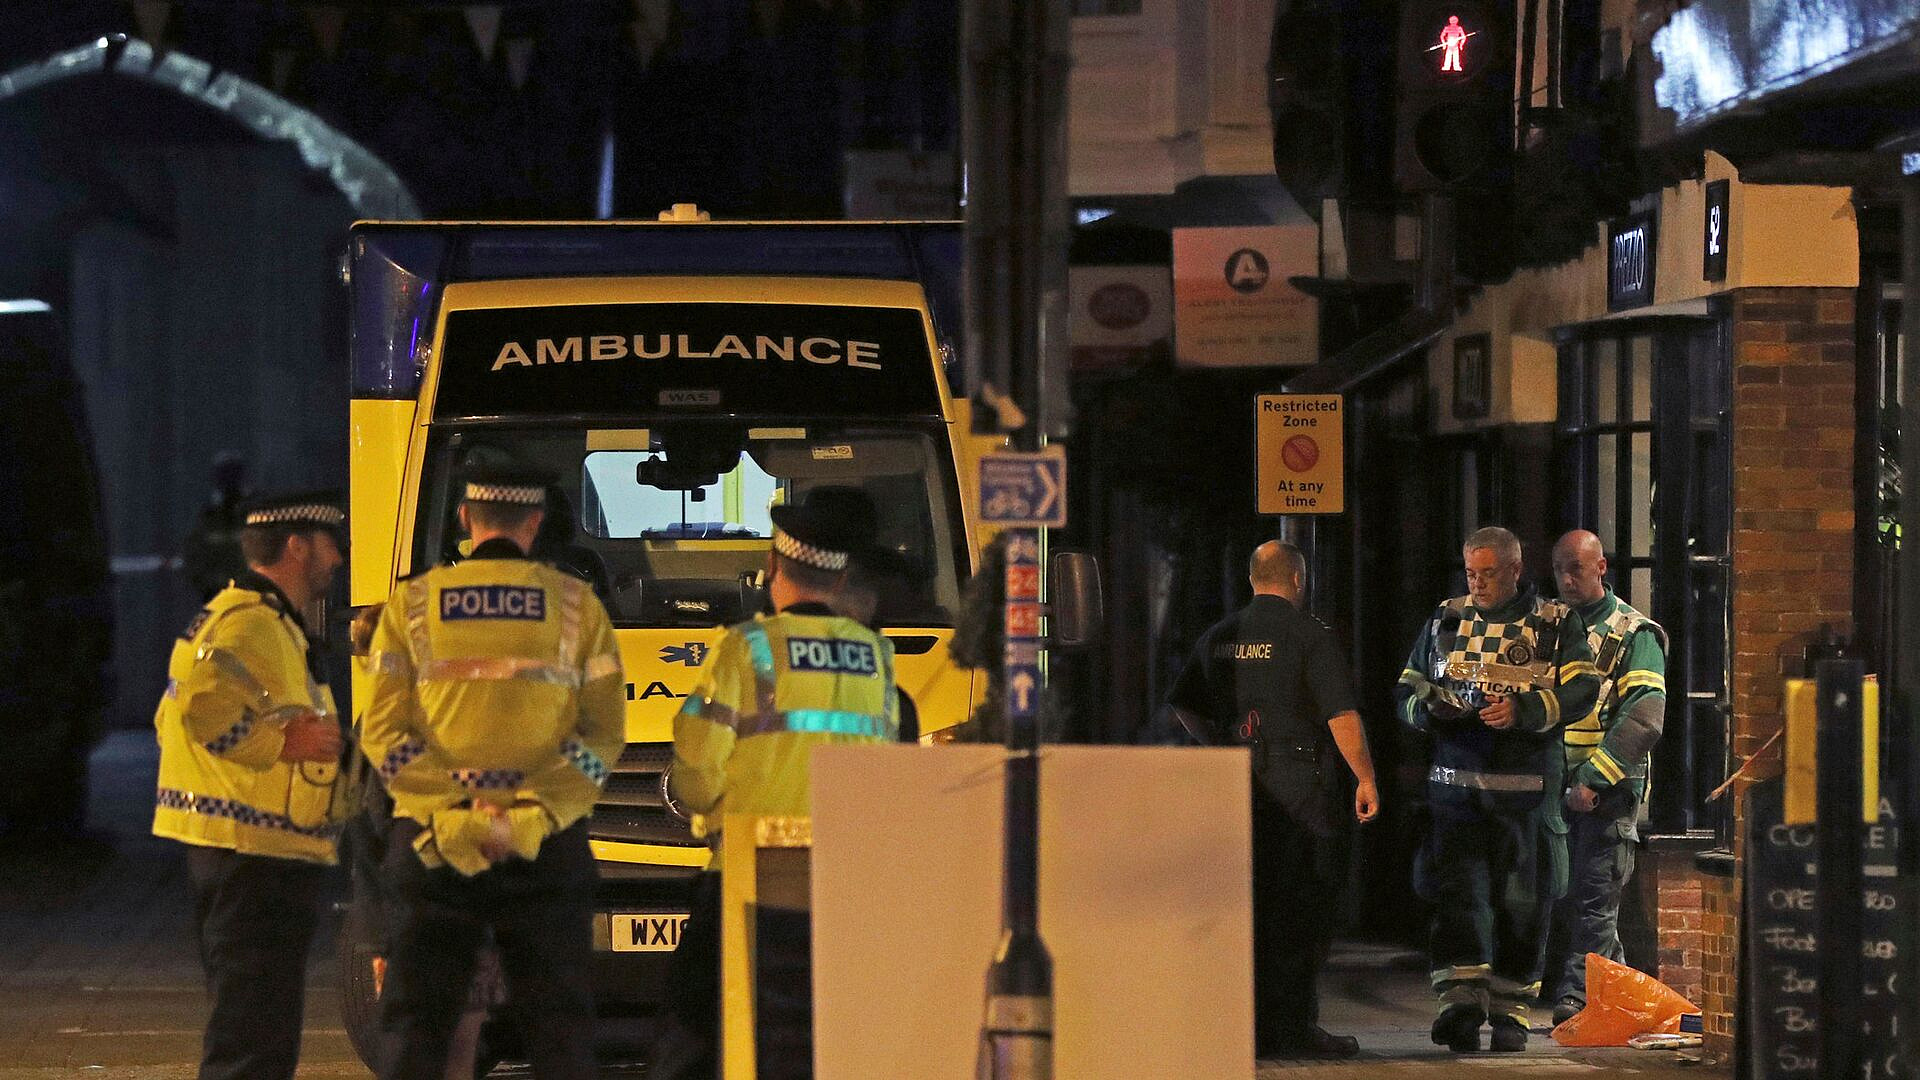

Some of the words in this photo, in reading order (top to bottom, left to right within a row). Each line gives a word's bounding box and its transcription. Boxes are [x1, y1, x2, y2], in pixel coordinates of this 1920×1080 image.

[491, 334, 882, 371] AMBULANCE
[668, 392, 709, 402] WAS
[1263, 400, 1337, 412] Restricted
[1283, 416, 1318, 427] Zone
[1278, 480, 1294, 492] At
[1299, 482, 1324, 494] any
[1285, 496, 1317, 507] time
[443, 590, 541, 616] POLICE
[791, 640, 876, 672] POLICE
[1451, 680, 1522, 695] TACTICAL
